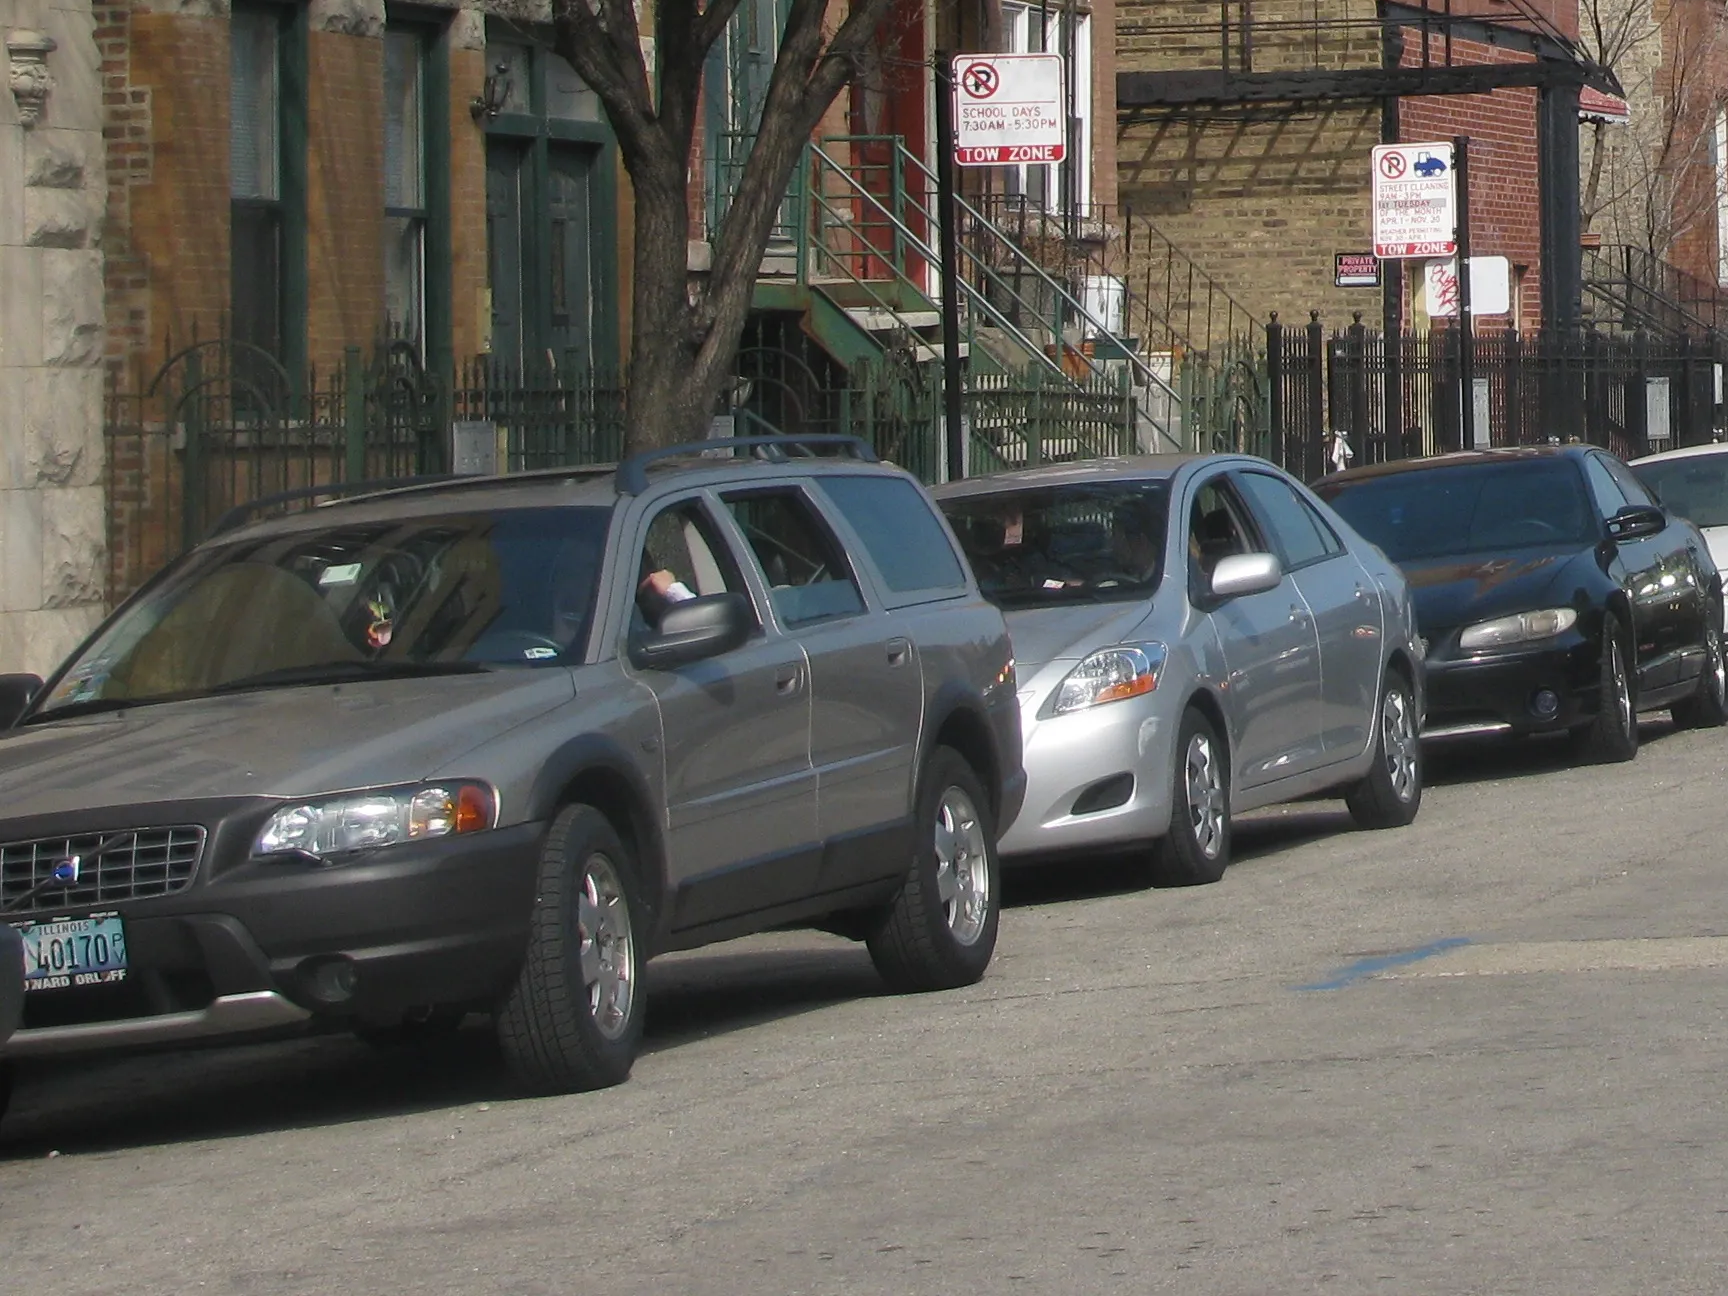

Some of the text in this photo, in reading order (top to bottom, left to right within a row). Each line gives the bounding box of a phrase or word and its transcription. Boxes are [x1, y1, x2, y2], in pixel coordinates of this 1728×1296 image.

[962, 106, 1041, 119] SCHOOL DAYS
[963, 120, 1005, 132] 7:30AM
[1014, 118, 1057, 130] 5:30PM
[963, 146, 1055, 162] TOW ZONE
[1379, 181, 1449, 192] STREET CLEANING
[1393, 199, 1431, 208] TUESDAY
[1379, 206, 1442, 217] OF THE MONTH
[1380, 242, 1449, 255] TOW ZONE
[1342, 256, 1374, 265] PRIVATE
[1338, 264, 1377, 273] PROPERTY
[39, 921, 89, 936] ILLINOIS
[37, 933, 108, 972] 40170
